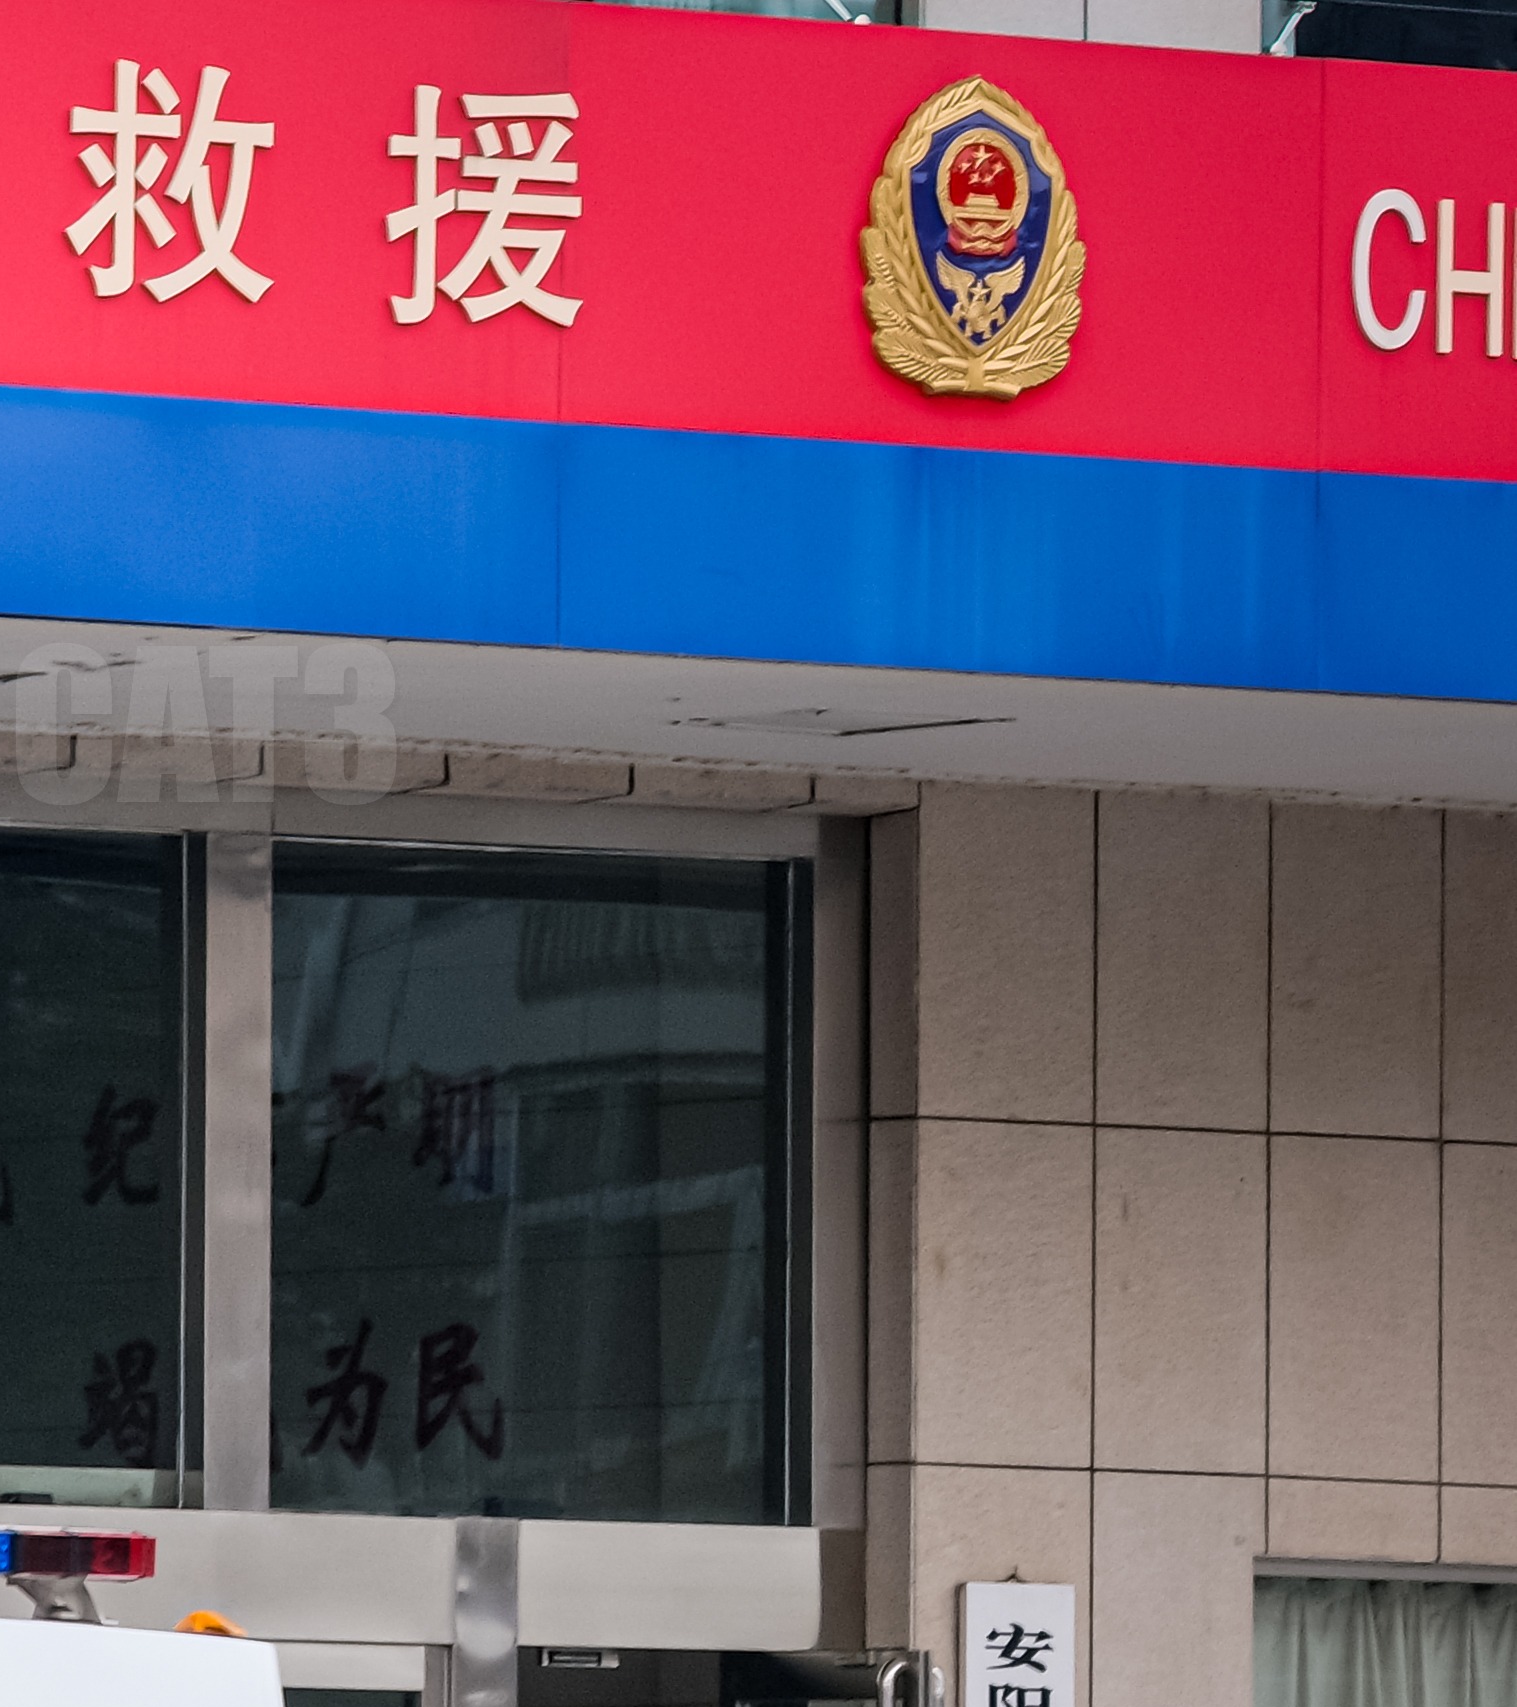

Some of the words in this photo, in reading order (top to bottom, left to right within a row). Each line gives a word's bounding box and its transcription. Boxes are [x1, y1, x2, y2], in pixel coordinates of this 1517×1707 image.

[1352, 187, 1517, 360] CH
[82, 1068, 496, 1206] 纪严明
[80, 1319, 504, 1471] 竭为民
